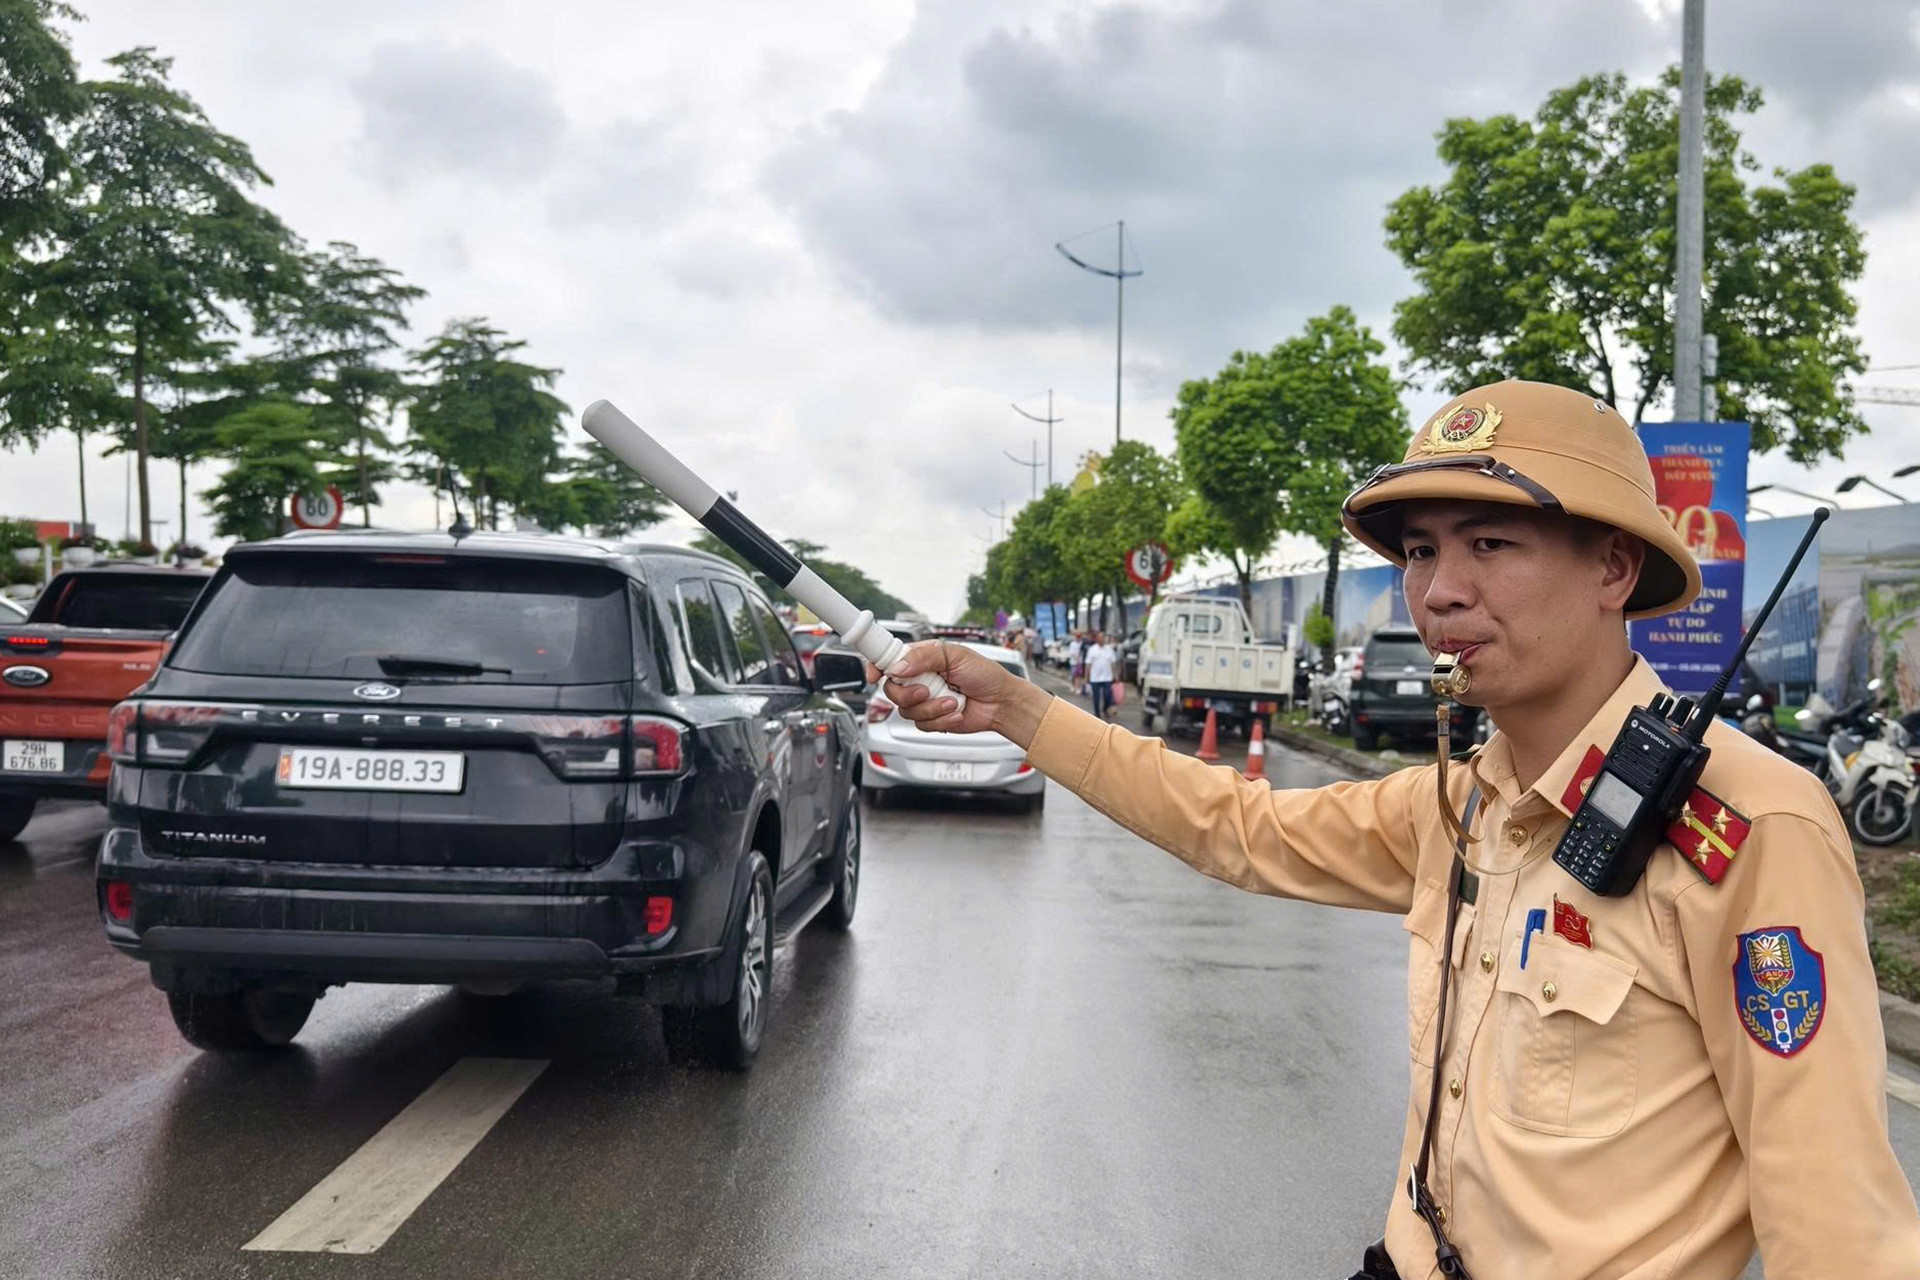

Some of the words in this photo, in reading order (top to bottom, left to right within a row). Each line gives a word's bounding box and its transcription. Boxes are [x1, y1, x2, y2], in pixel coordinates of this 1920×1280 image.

[1686, 617, 1706, 628] DO
[242, 711, 503, 728] EVEREST
[1638, 726, 1670, 749] MOTOROLA
[21, 742, 47, 755] 29H
[298, 756, 446, 783] 19A-888.33
[161, 830, 266, 843] TITANIUM
